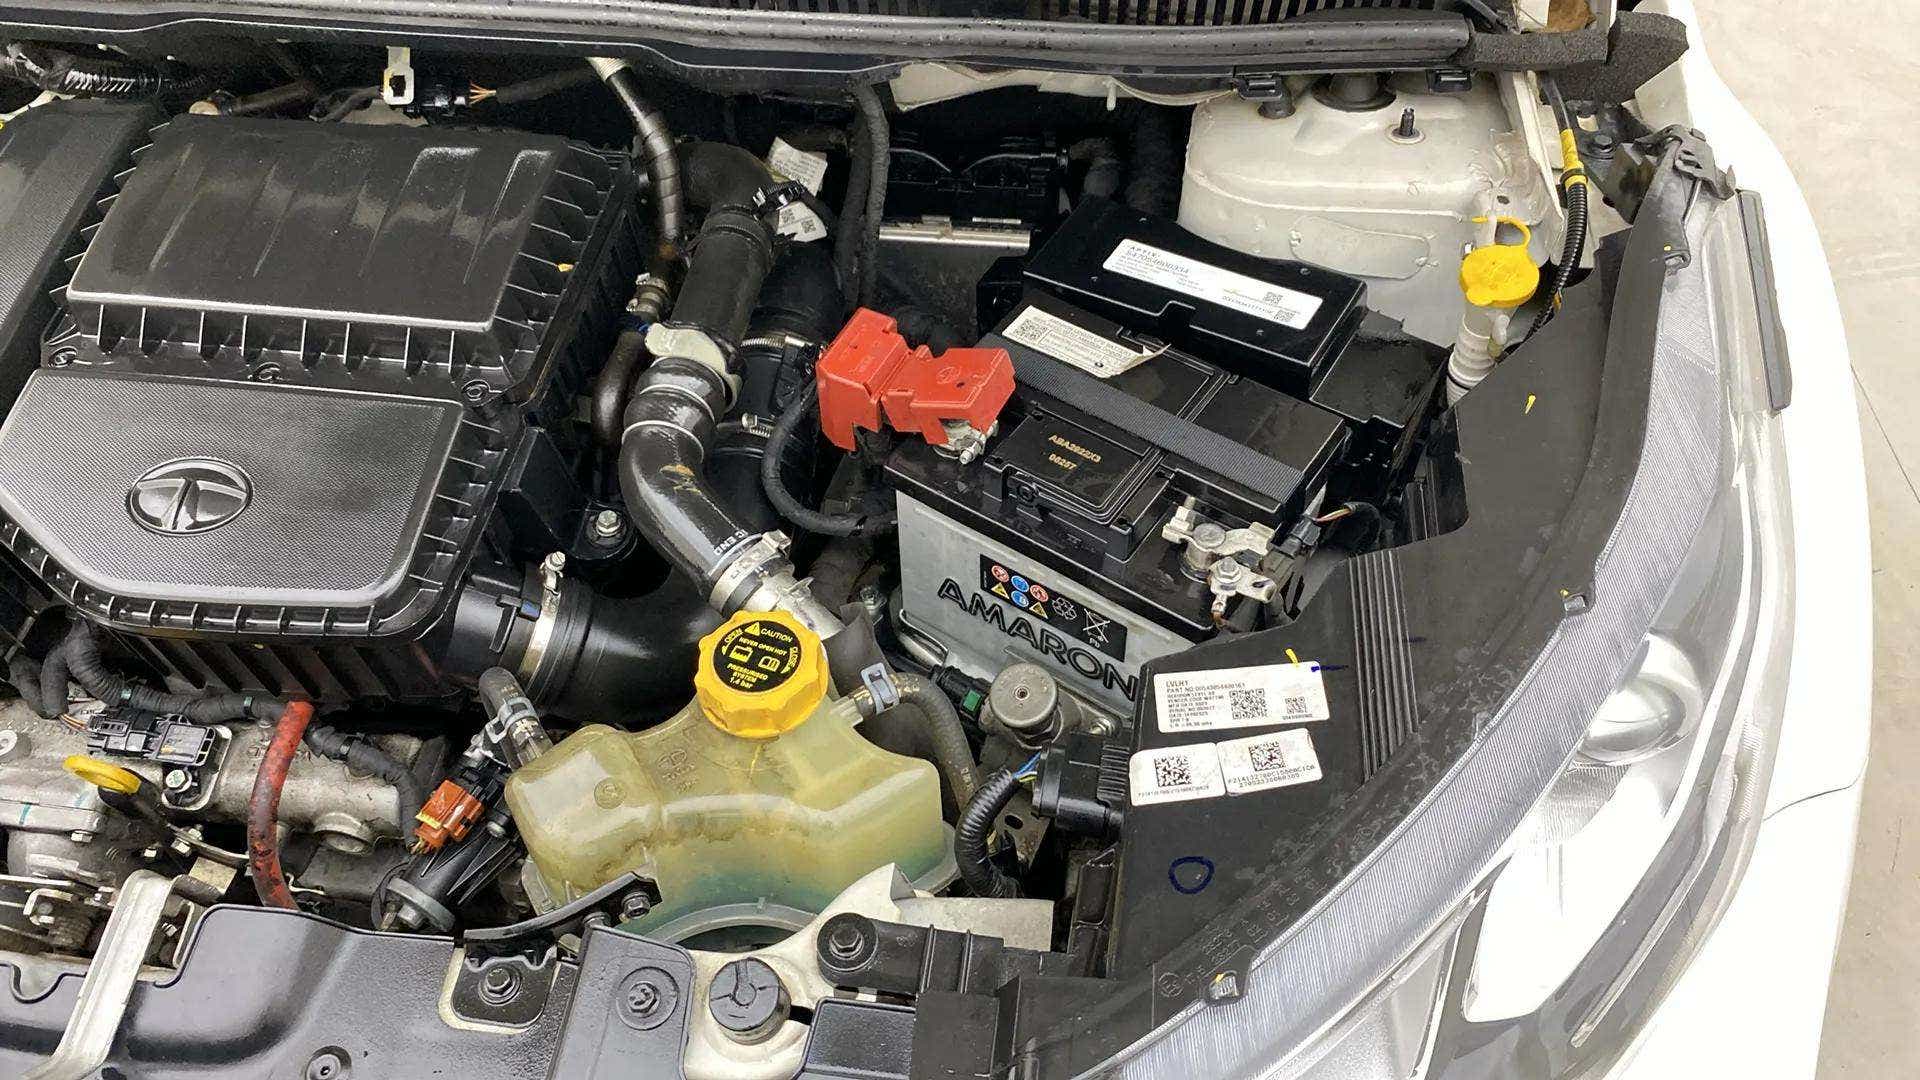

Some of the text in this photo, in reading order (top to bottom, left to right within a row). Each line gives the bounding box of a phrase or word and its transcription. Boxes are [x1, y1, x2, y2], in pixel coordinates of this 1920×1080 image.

[713, 535, 737, 556] END
[760, 628, 793, 643] CAUTION
[937, 577, 1140, 702] AMARON
[739, 636, 788, 656] NEVER OPEN NOT
[732, 671, 757, 684] SYSTEM
[740, 680, 754, 689] bar
